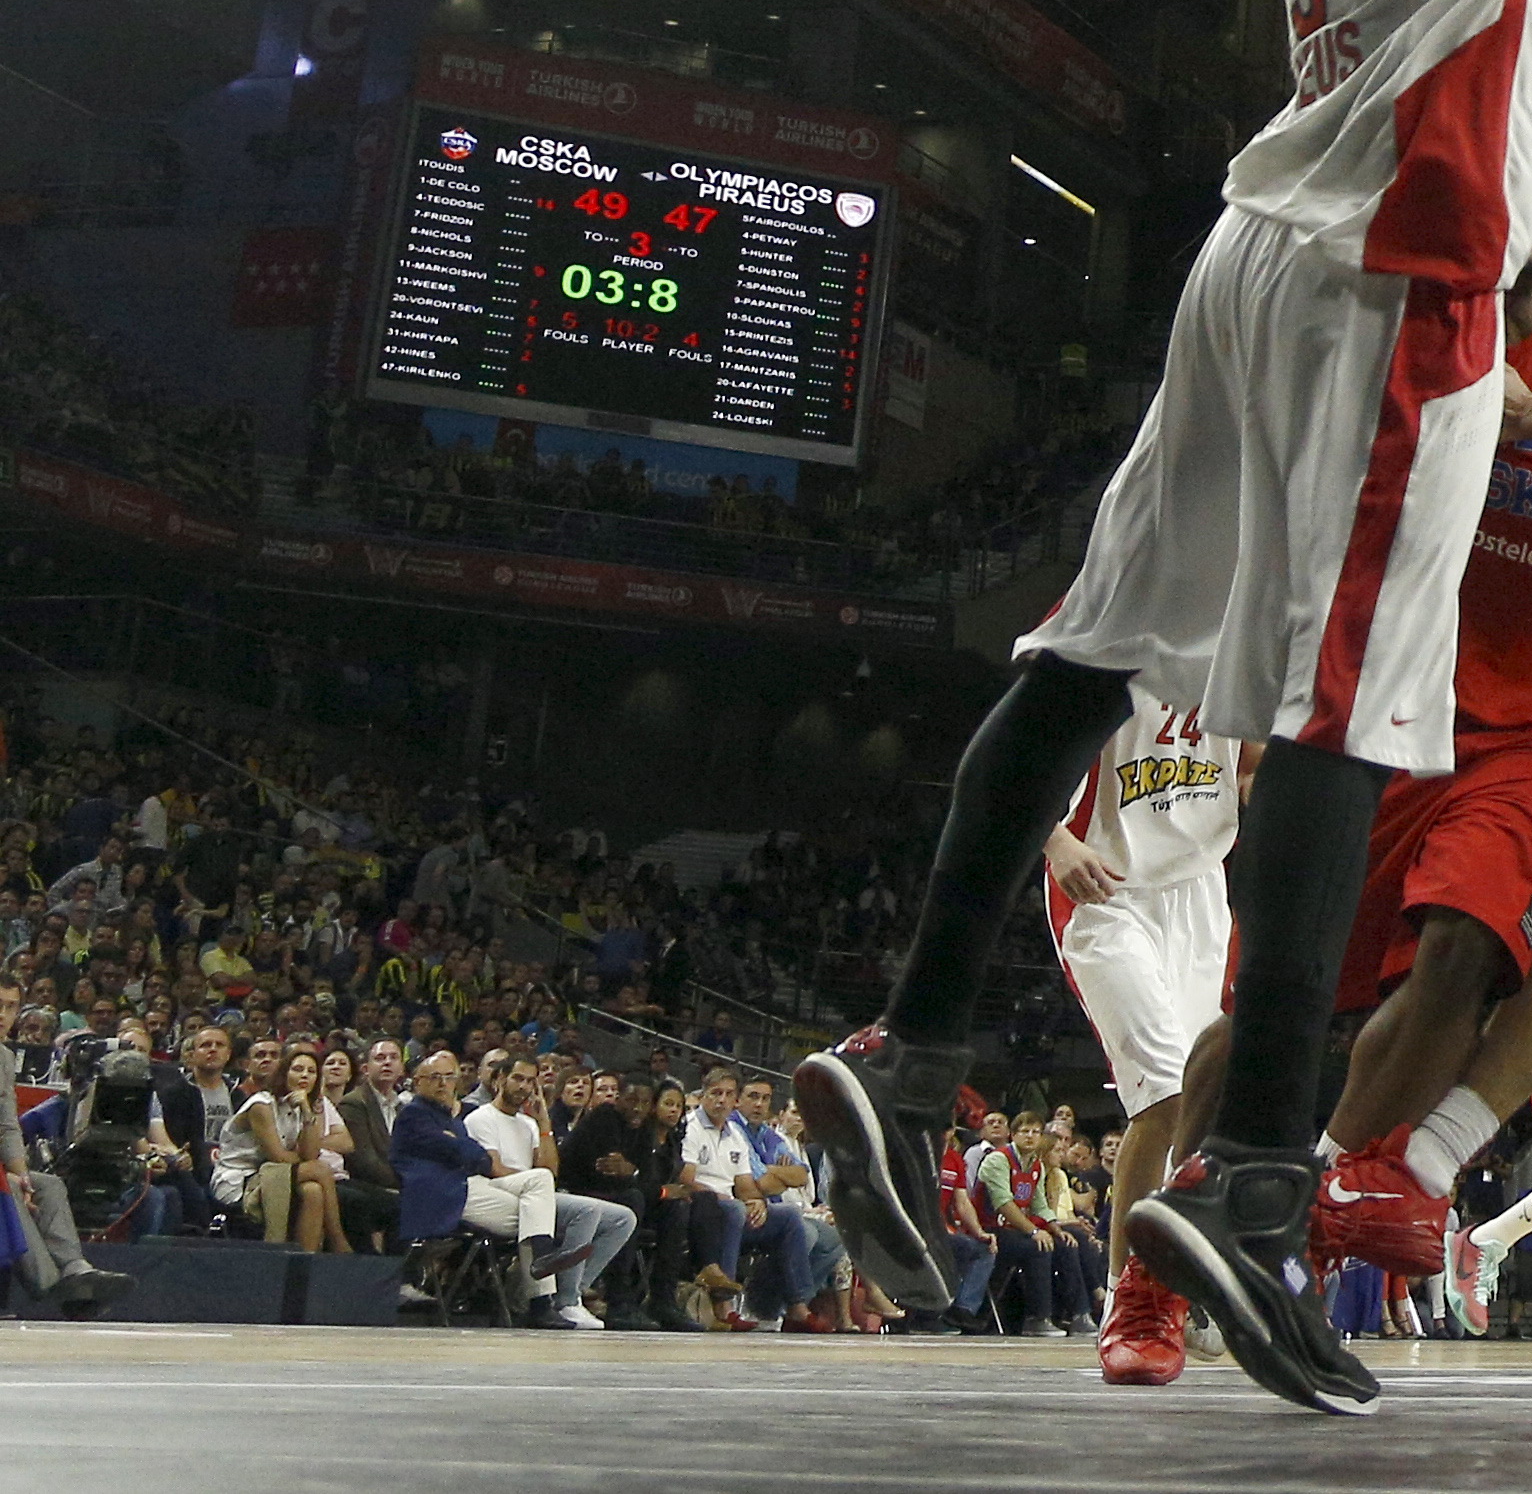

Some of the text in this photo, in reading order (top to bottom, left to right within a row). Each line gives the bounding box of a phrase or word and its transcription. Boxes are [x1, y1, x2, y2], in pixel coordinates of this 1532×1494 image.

[530, 69, 603, 92] TURKISH
[526, 83, 600, 106] AIRLINES
[777, 116, 846, 139] TURKISH
[520, 136, 591, 161] CSKA
[774, 129, 845, 152] AIRLINES
[419, 159, 465, 173] ITOUDIS
[495, 148, 618, 182] MOSCOW
[448, 180, 480, 193] COLO
[670, 163, 832, 204] OLYMPIACOS
[572, 188, 629, 220] 49
[699, 184, 805, 215] PIRAEUS
[663, 204, 719, 233] 47
[584, 231, 603, 242] TO
[628, 231, 652, 256] 3
[742, 232, 797, 247] 4-PETWAY
[408, 244, 472, 261] 9-JACKSON
[613, 255, 663, 270] PERIOD
[681, 247, 698, 257] TO
[562, 265, 678, 312] 03:8
[544, 329, 589, 343] FOULS
[602, 339, 654, 353] PLAYER
[683, 332, 699, 347] 4
[669, 349, 713, 362] FOULS
[1156, 704, 1202, 746] 24
